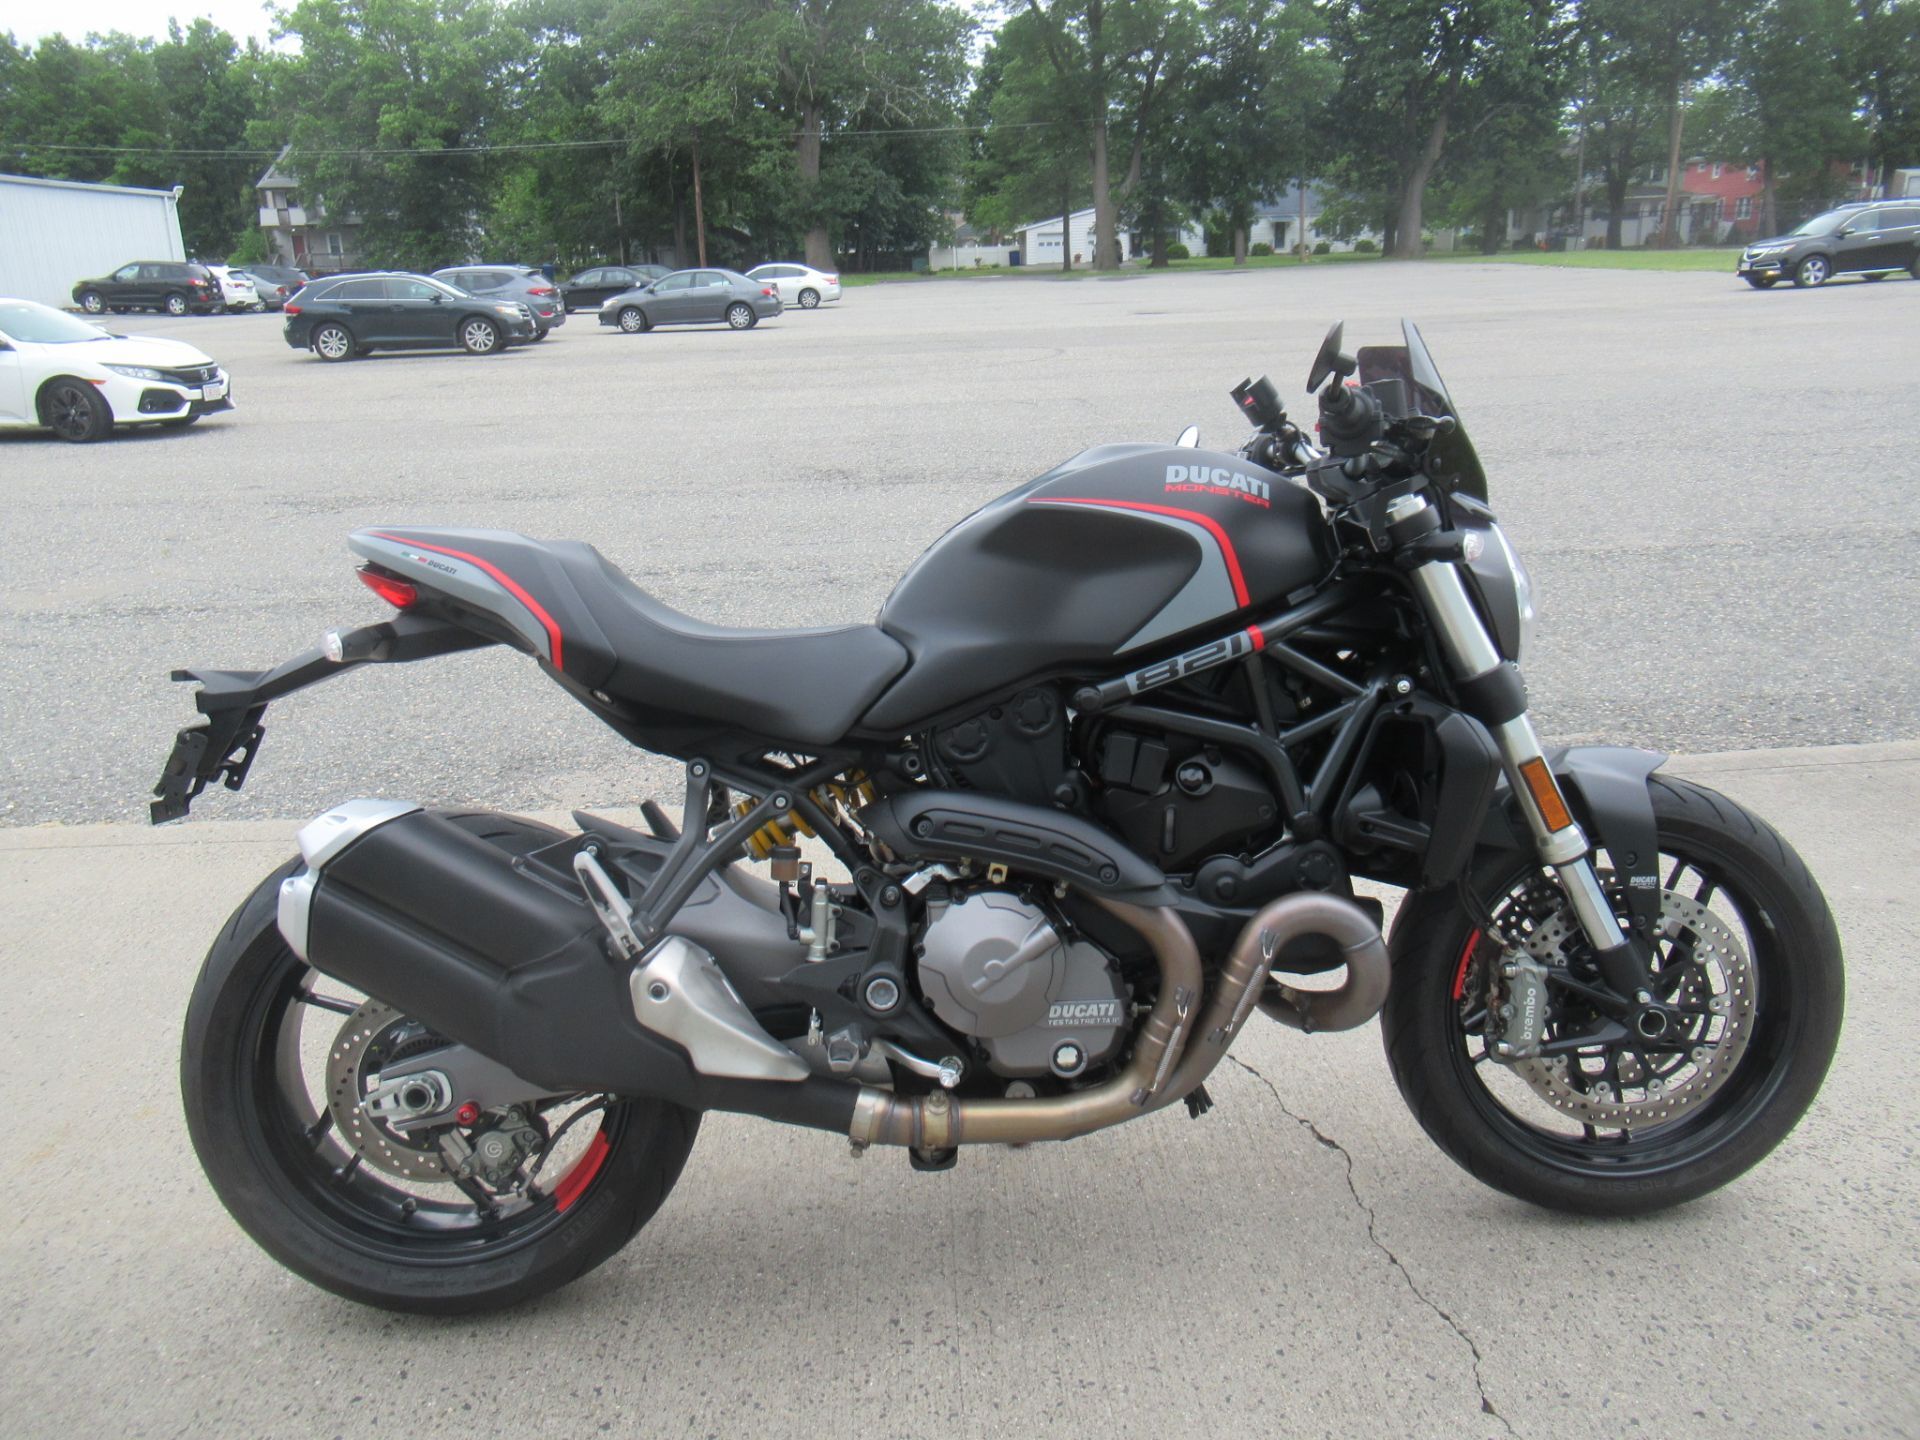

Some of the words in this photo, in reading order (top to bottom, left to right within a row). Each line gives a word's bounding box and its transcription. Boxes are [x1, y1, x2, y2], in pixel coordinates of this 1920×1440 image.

[1165, 465, 1270, 500] DUCATI
[1164, 483, 1271, 509] MONSTER
[427, 560, 458, 575] DUCATI
[1135, 635, 1242, 690] 821
[1629, 876, 1657, 884] DUCATI
[1048, 1003, 1115, 1018] DUCATI
[1521, 988, 1537, 1040] brembo
